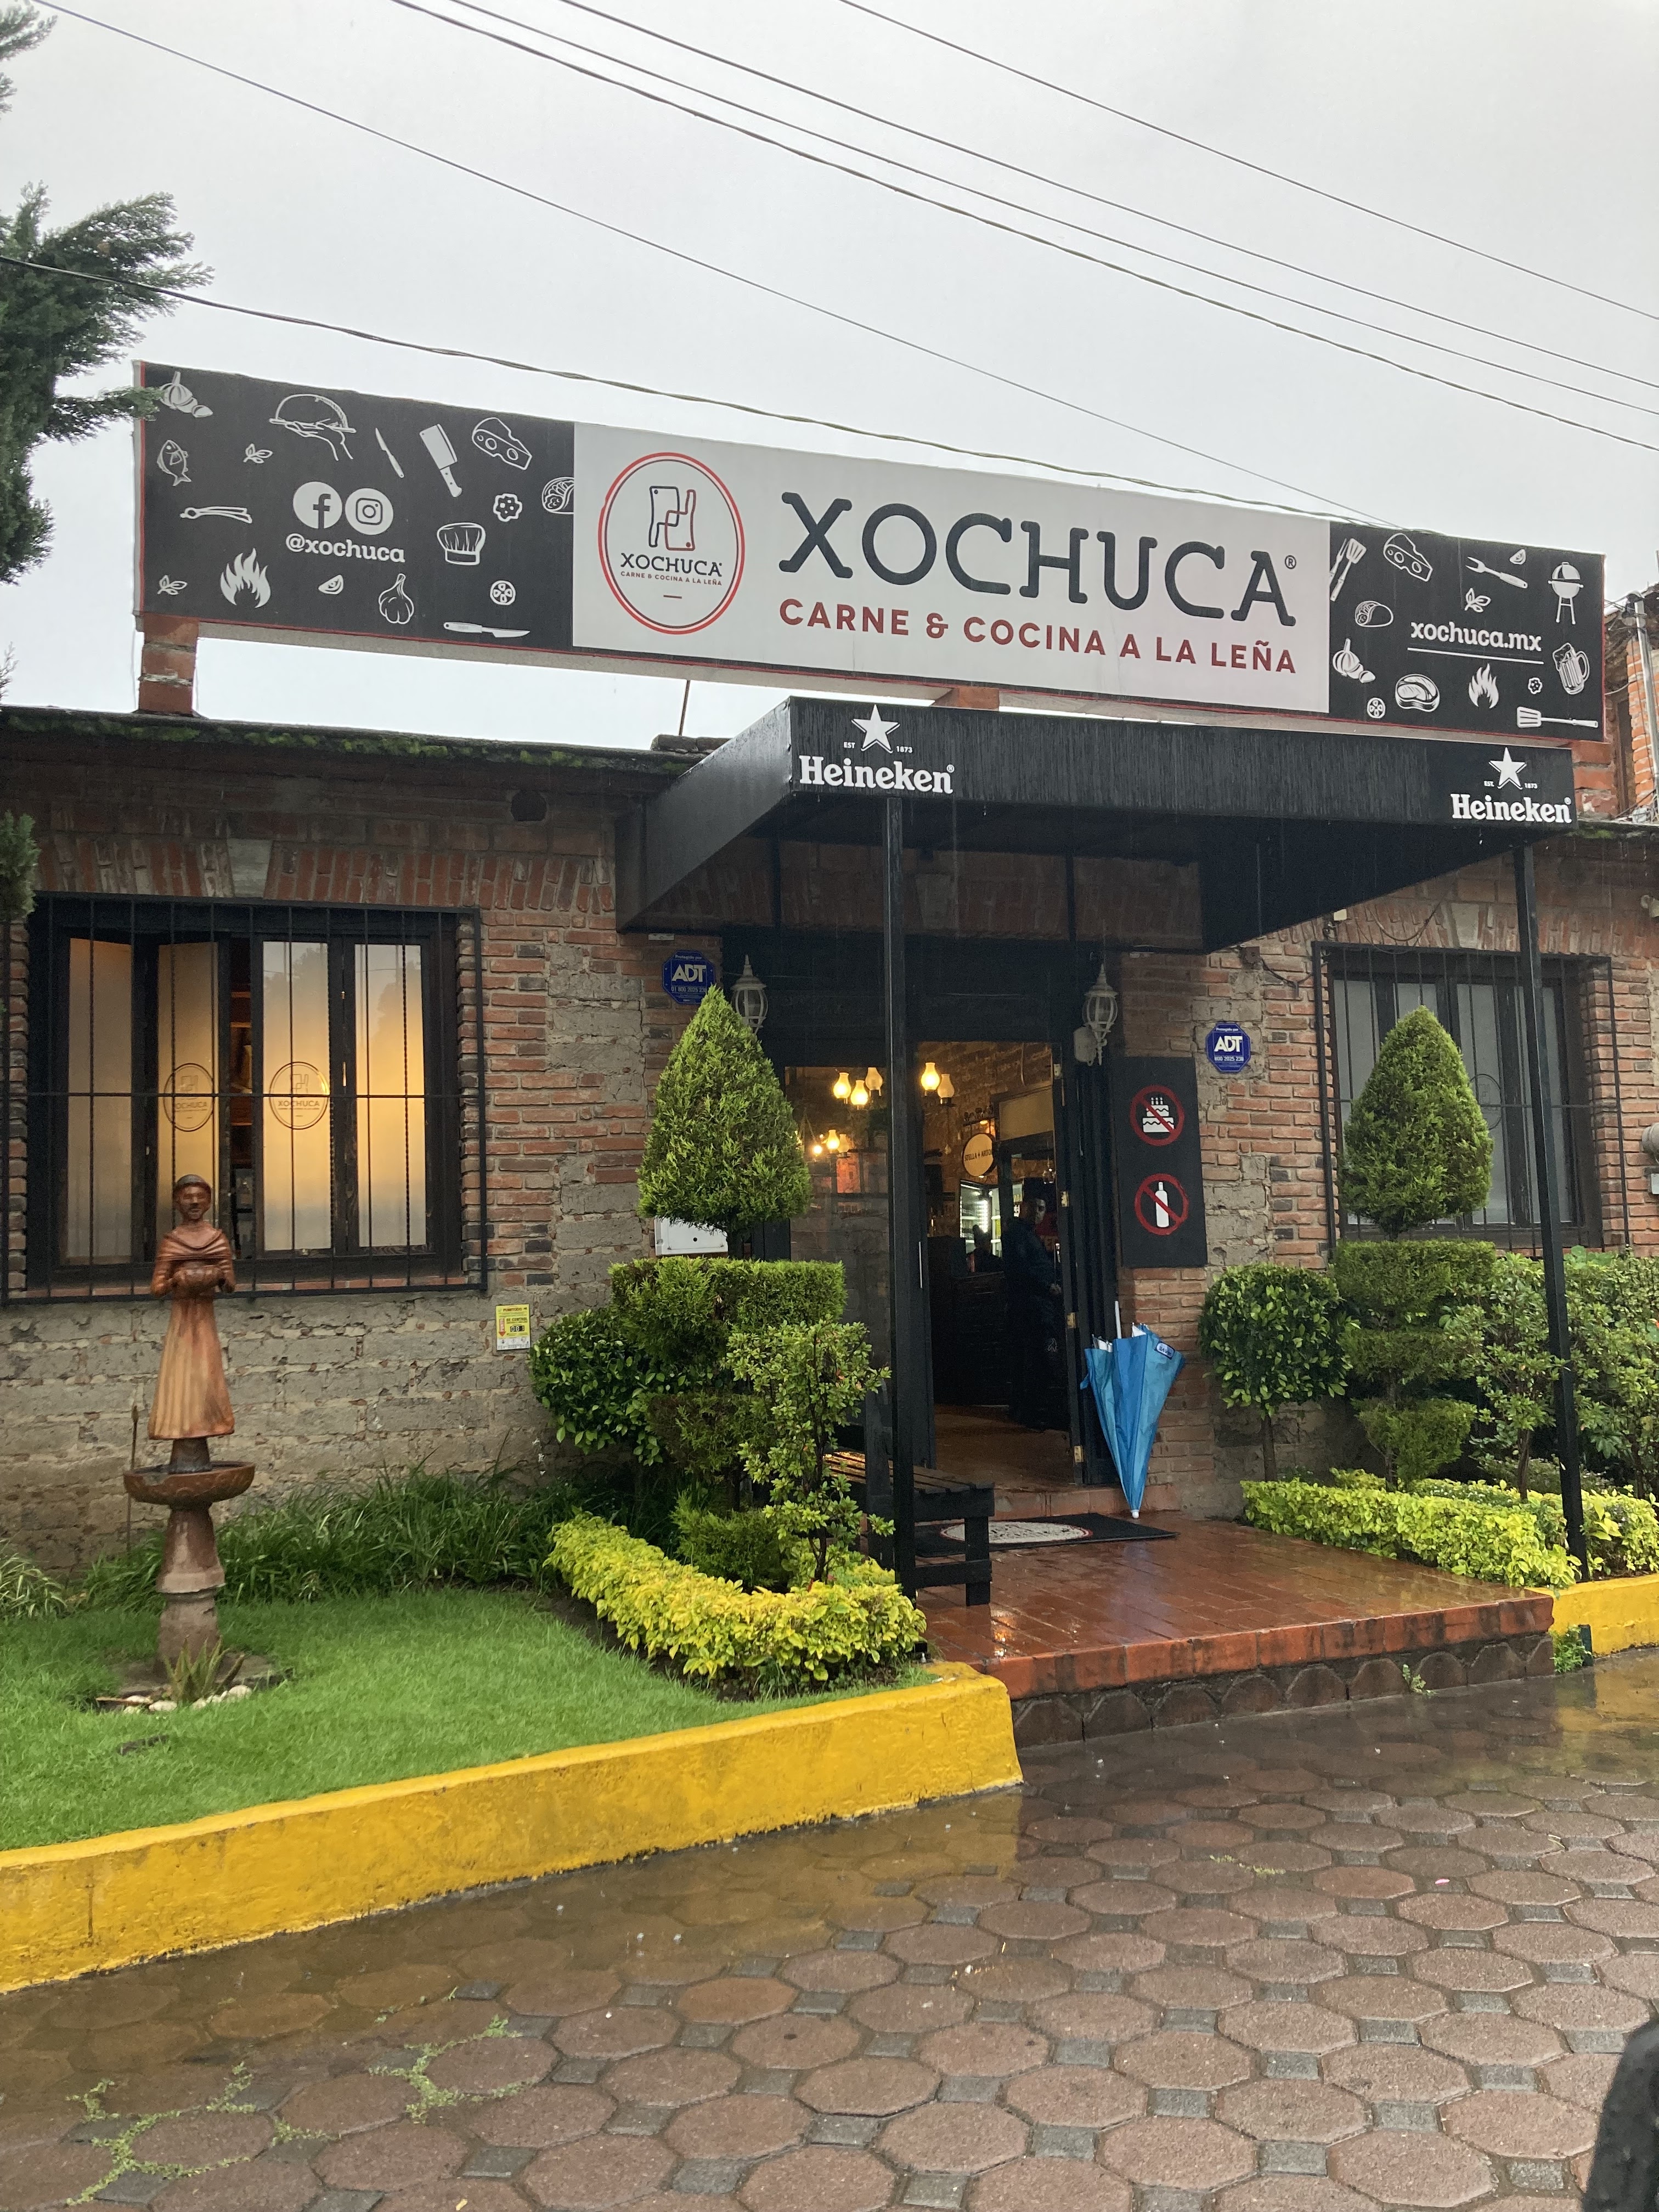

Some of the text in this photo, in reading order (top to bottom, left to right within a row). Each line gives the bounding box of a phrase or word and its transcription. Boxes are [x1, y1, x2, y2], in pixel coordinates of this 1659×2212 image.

[285, 533, 405, 563] @xochuca
[780, 599, 1296, 674] CARNE & COCINA A LA LEÑA
[1410, 621, 1542, 652] xochuca.mx
[672, 964, 707, 982] ADT
[1214, 1035, 1243, 1052] ADT
[964, 1152, 977, 1161] STELLA
